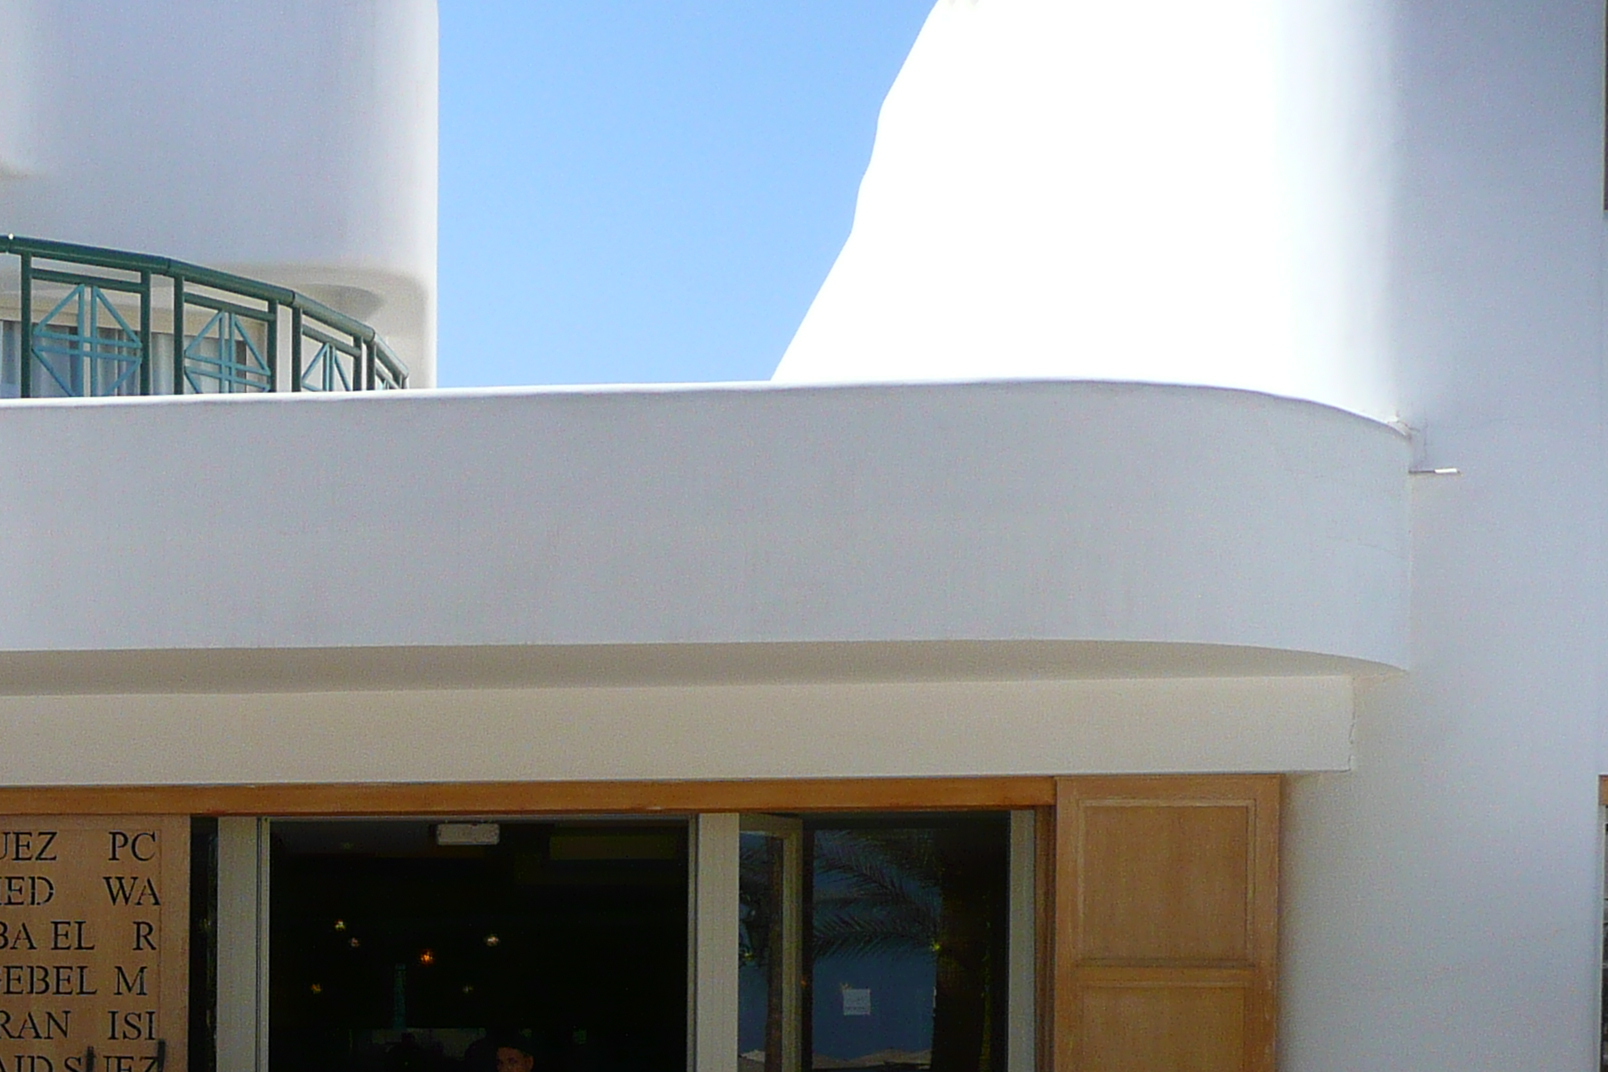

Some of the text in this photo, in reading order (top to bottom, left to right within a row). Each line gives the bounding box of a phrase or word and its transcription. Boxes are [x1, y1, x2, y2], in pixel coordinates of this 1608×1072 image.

[108, 831, 156, 861] PC
[103, 876, 161, 906] WA
[51, 921, 95, 950] EL
[133, 921, 157, 951] R
[114, 966, 148, 995] M
